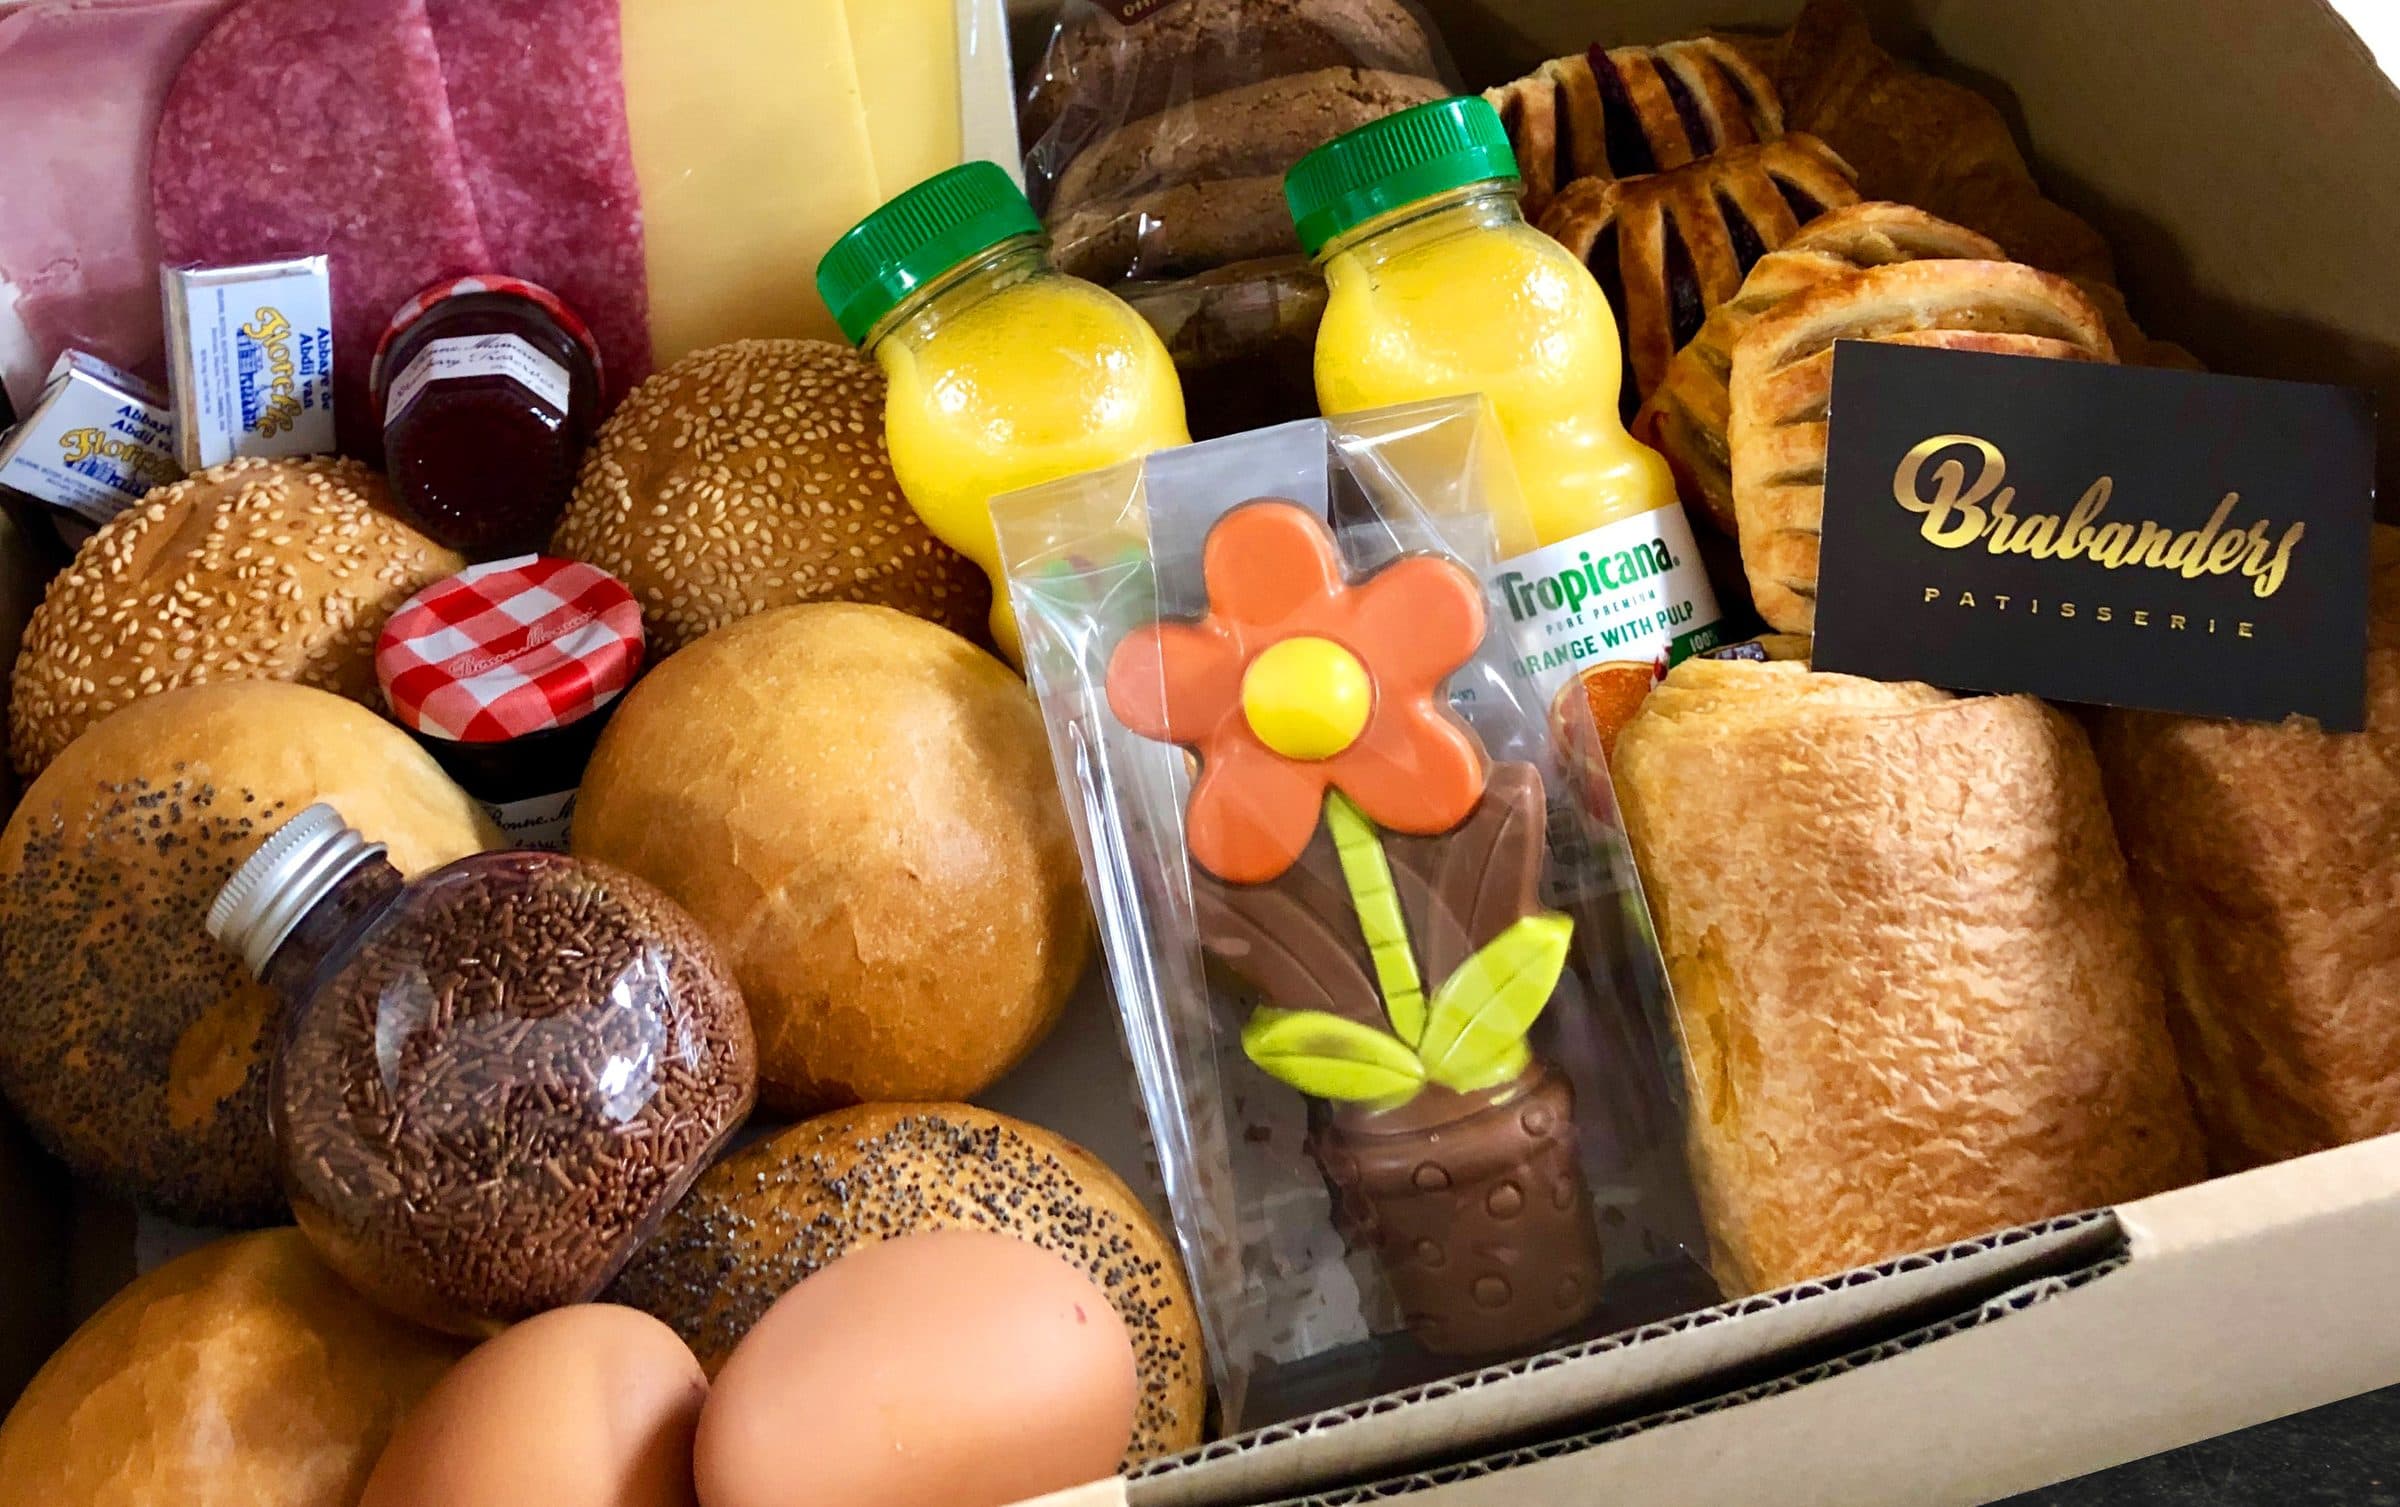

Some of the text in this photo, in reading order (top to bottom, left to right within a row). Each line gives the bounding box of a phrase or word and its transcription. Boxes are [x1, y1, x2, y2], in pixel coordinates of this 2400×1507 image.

[300, 333, 314, 375] Abdij
[318, 328, 330, 386] Abbaye
[111, 420, 155, 444] Abdij
[1893, 434, 2305, 598] Brabanders
[1497, 537, 1674, 622] Tropicana
[1513, 600, 1694, 678] ORANGE WITH PULP
[1546, 589, 1655, 635] PURE PREMIUM
[1924, 587, 2254, 638] PATISSERIE
